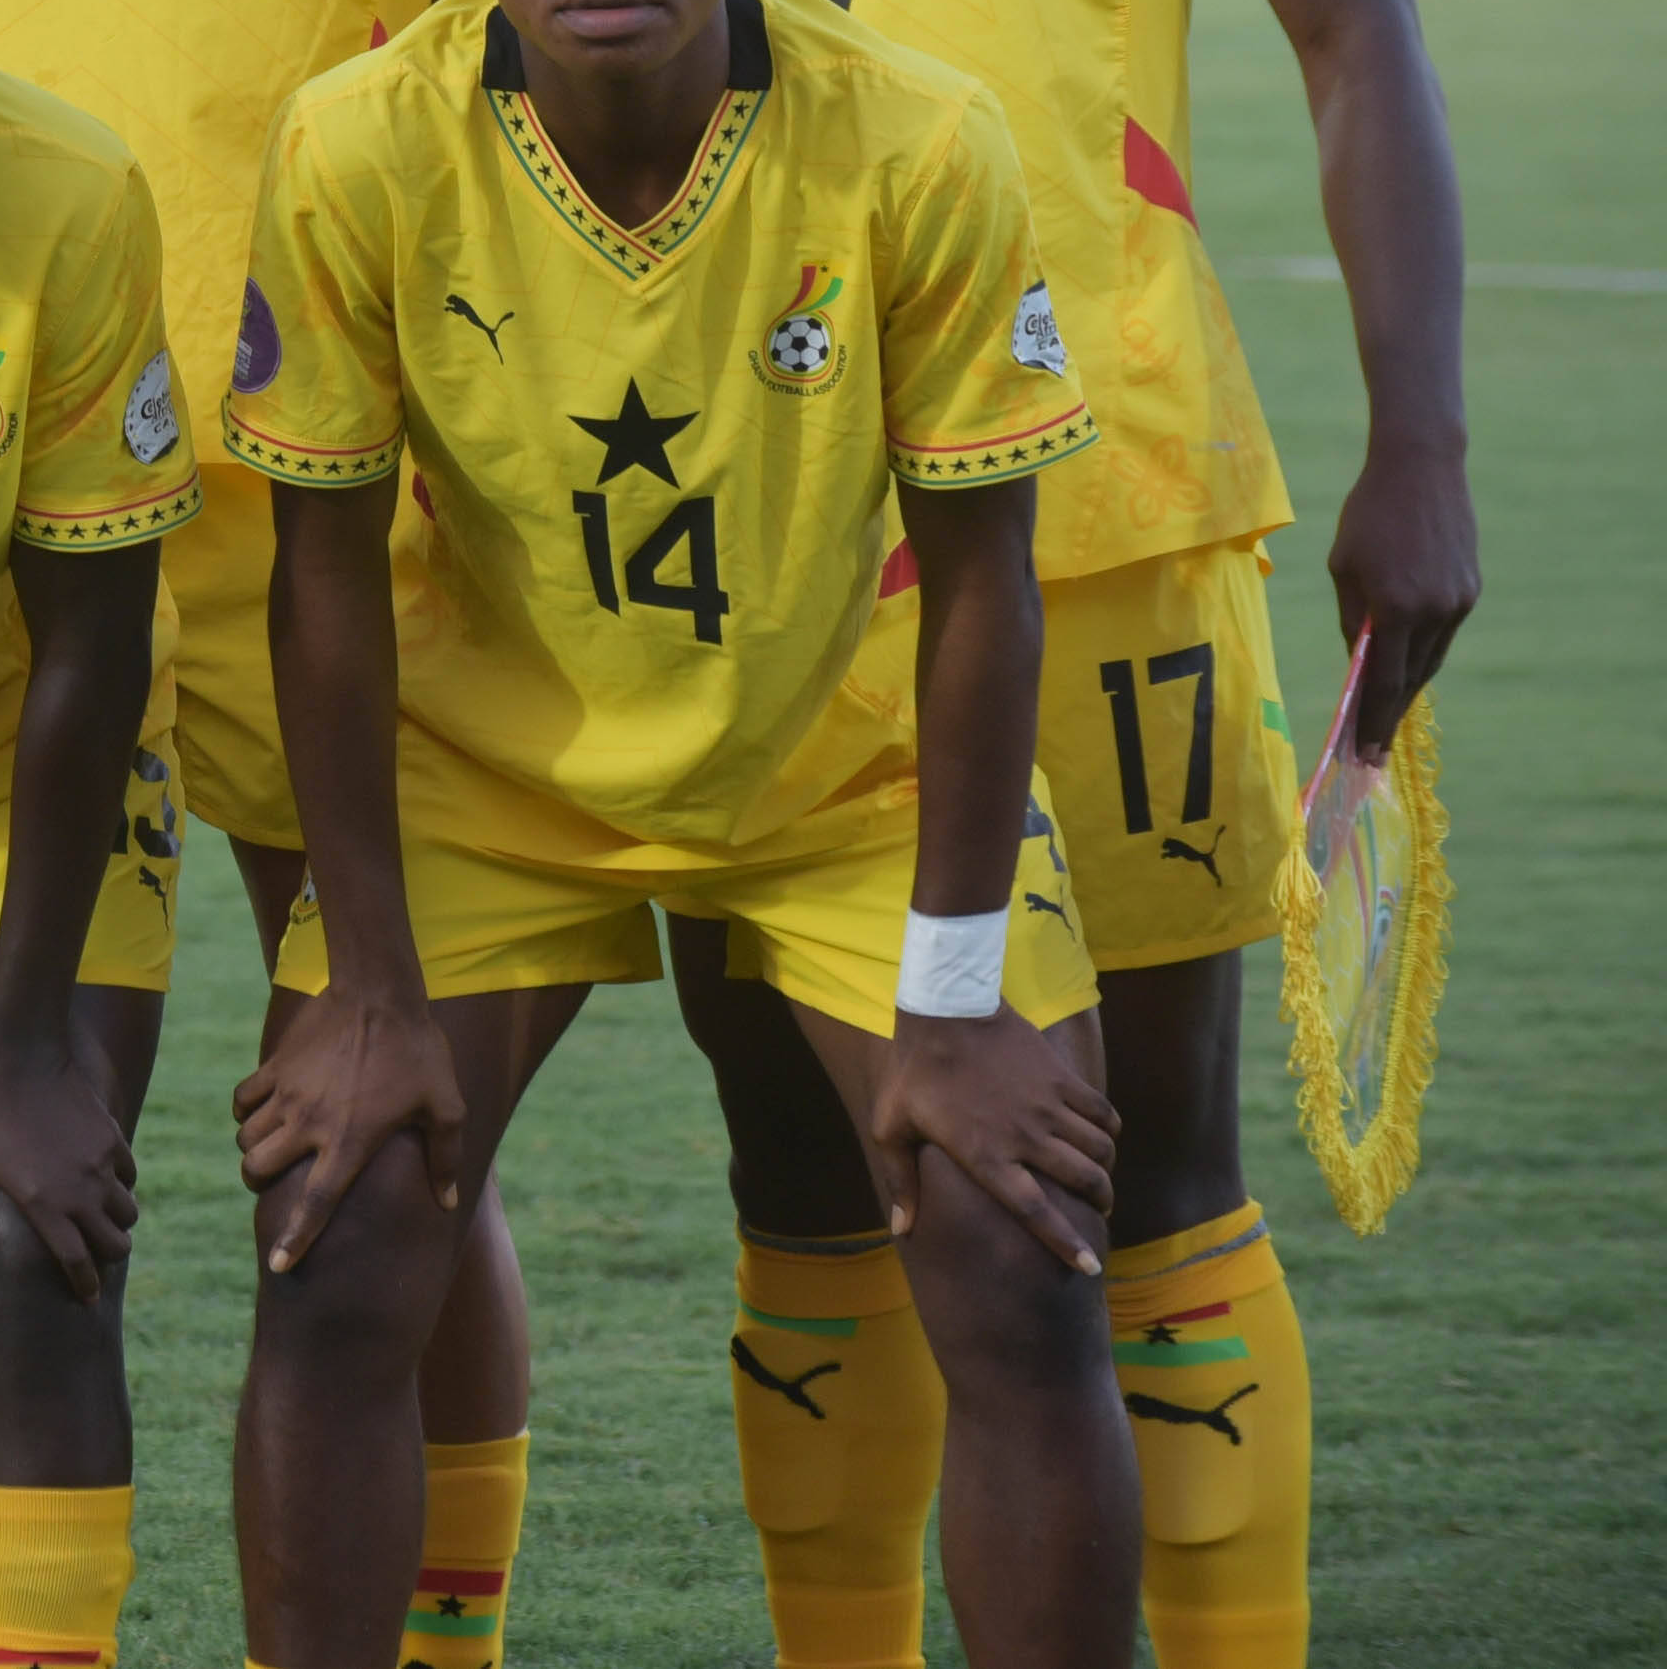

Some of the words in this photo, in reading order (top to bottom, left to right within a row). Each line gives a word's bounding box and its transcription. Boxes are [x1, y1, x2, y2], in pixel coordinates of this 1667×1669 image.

[813, 344, 847, 396] ASSOCIATION
[572, 489, 731, 646] 14
[1099, 642, 1215, 835] 17
